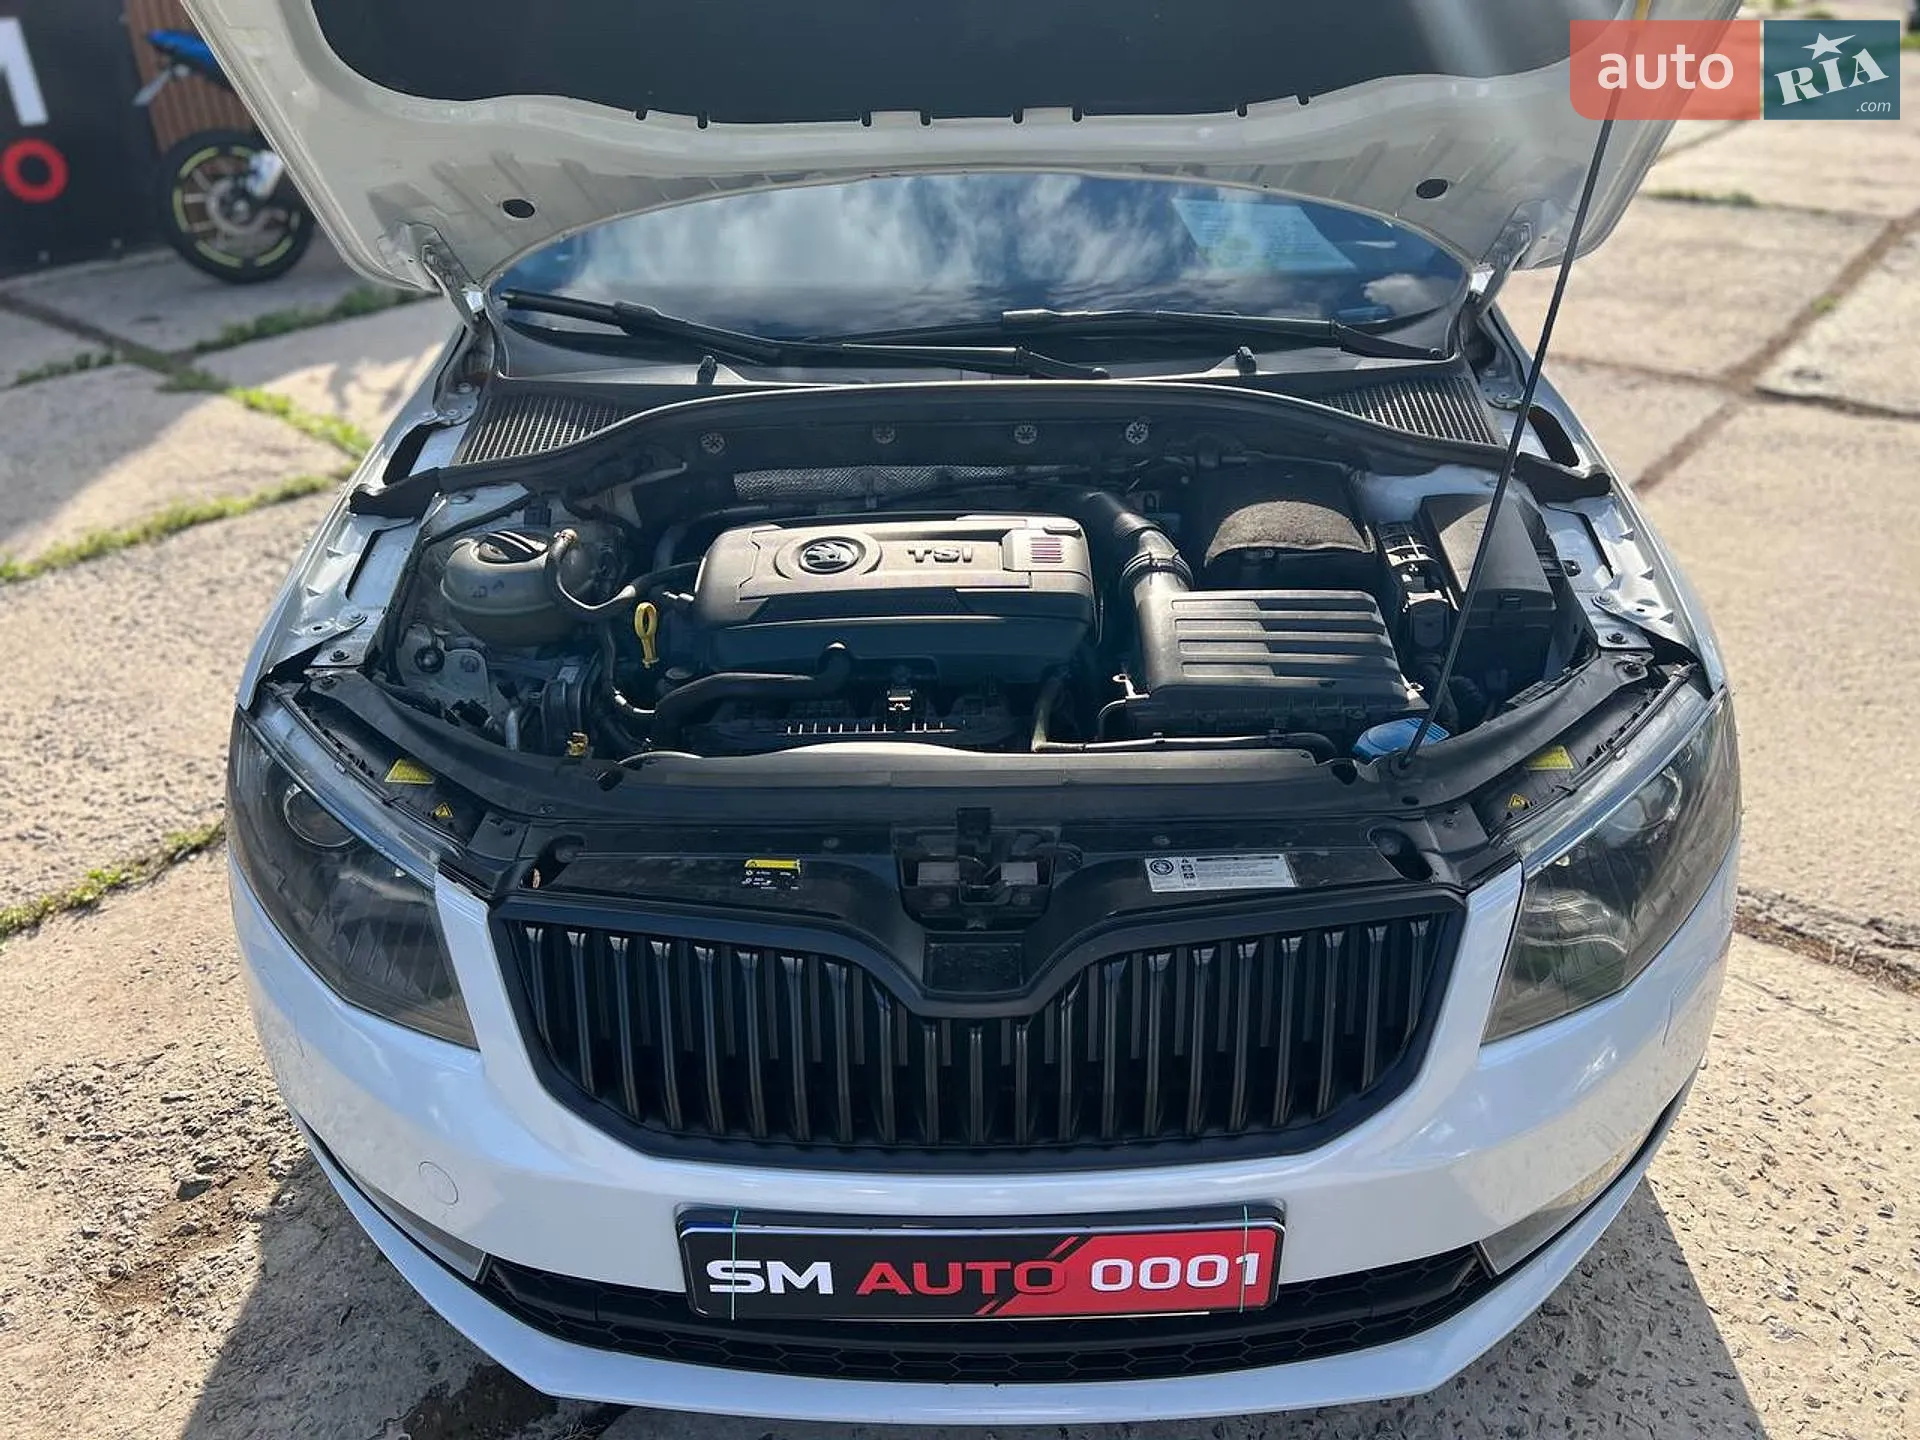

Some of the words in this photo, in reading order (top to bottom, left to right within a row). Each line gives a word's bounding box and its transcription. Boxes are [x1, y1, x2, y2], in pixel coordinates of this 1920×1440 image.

[907, 548, 974, 563] TSI
[708, 1260, 833, 1295] SM
[856, 1261, 1067, 1296] AUTO
[1090, 1252, 1260, 1291] 0001
